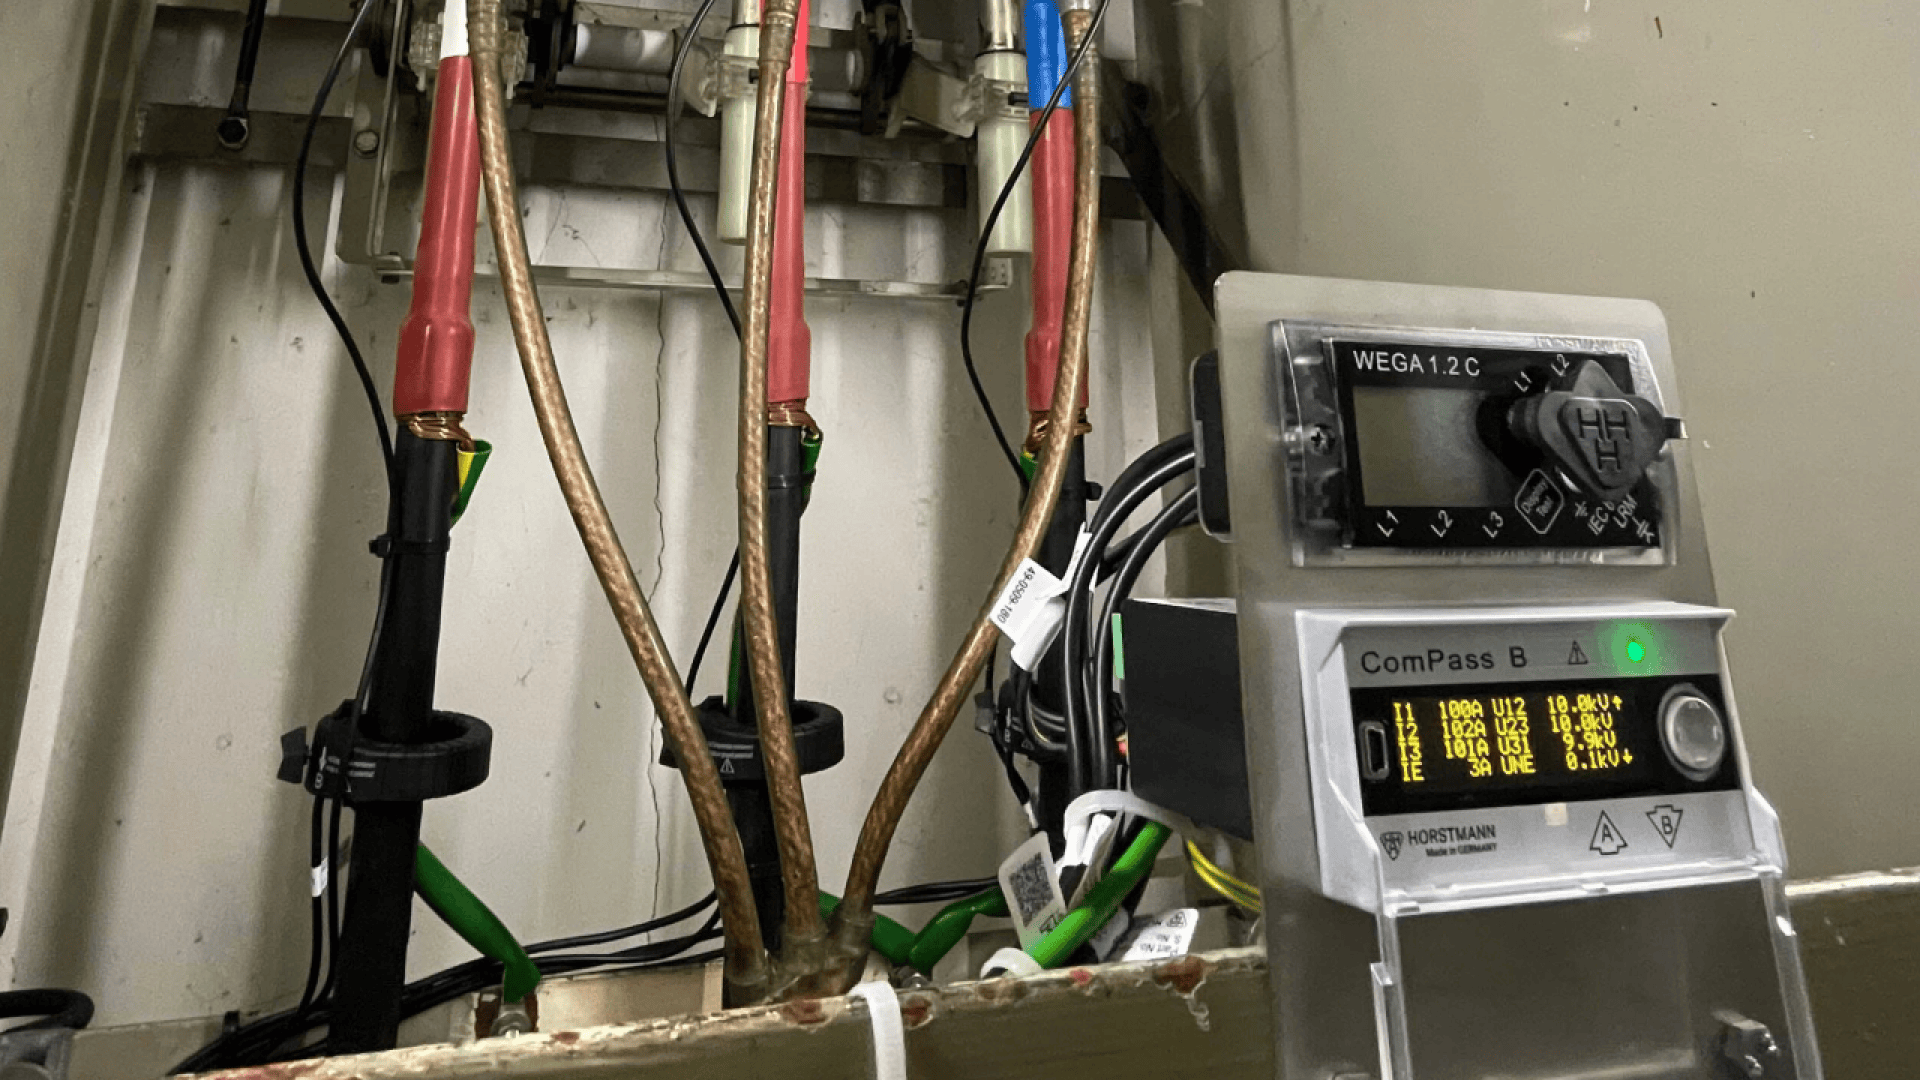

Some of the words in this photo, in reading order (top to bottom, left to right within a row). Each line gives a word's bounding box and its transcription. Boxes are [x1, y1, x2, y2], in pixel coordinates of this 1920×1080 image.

[1353, 350, 1424, 374] WEGA
[1429, 355, 1458, 376] 1.2
[1465, 356, 1480, 377] C
[1551, 353, 1570, 378] L2
[1515, 371, 1533, 393] L1
[1377, 510, 1400, 538] L1
[1430, 510, 1454, 538] L2
[1482, 510, 1505, 538] L3
[1587, 507, 1609, 536] IEC
[1612, 494, 1637, 528] LRM
[1361, 648, 1495, 674] ComPass
[1509, 646, 1528, 668] B
[1393, 702, 1416, 722] I1
[1439, 699, 1484, 719] 100A
[1491, 697, 1527, 717] U12
[1548, 693, 1609, 714] 10.0kV
[1396, 722, 1419, 742] I2
[1442, 719, 1487, 739] 102A
[1494, 716, 1530, 736] U23
[1551, 712, 1613, 733] 10.0kV
[1399, 741, 1422, 762] I3
[1444, 738, 1489, 759] 101A
[1497, 735, 1532, 756] U31
[1562, 731, 1617, 751] 9.9kV
[1402, 761, 1425, 782] IE
[1467, 758, 1492, 777] 3A
[1500, 755, 1537, 775] UNE
[1565, 749, 1620, 770] 0.1kV
[1407, 824, 1496, 846] HORSTMANN
[1601, 828, 1614, 842] A
[1661, 817, 1674, 835] B
[1458, 842, 1497, 854] GERMANY
